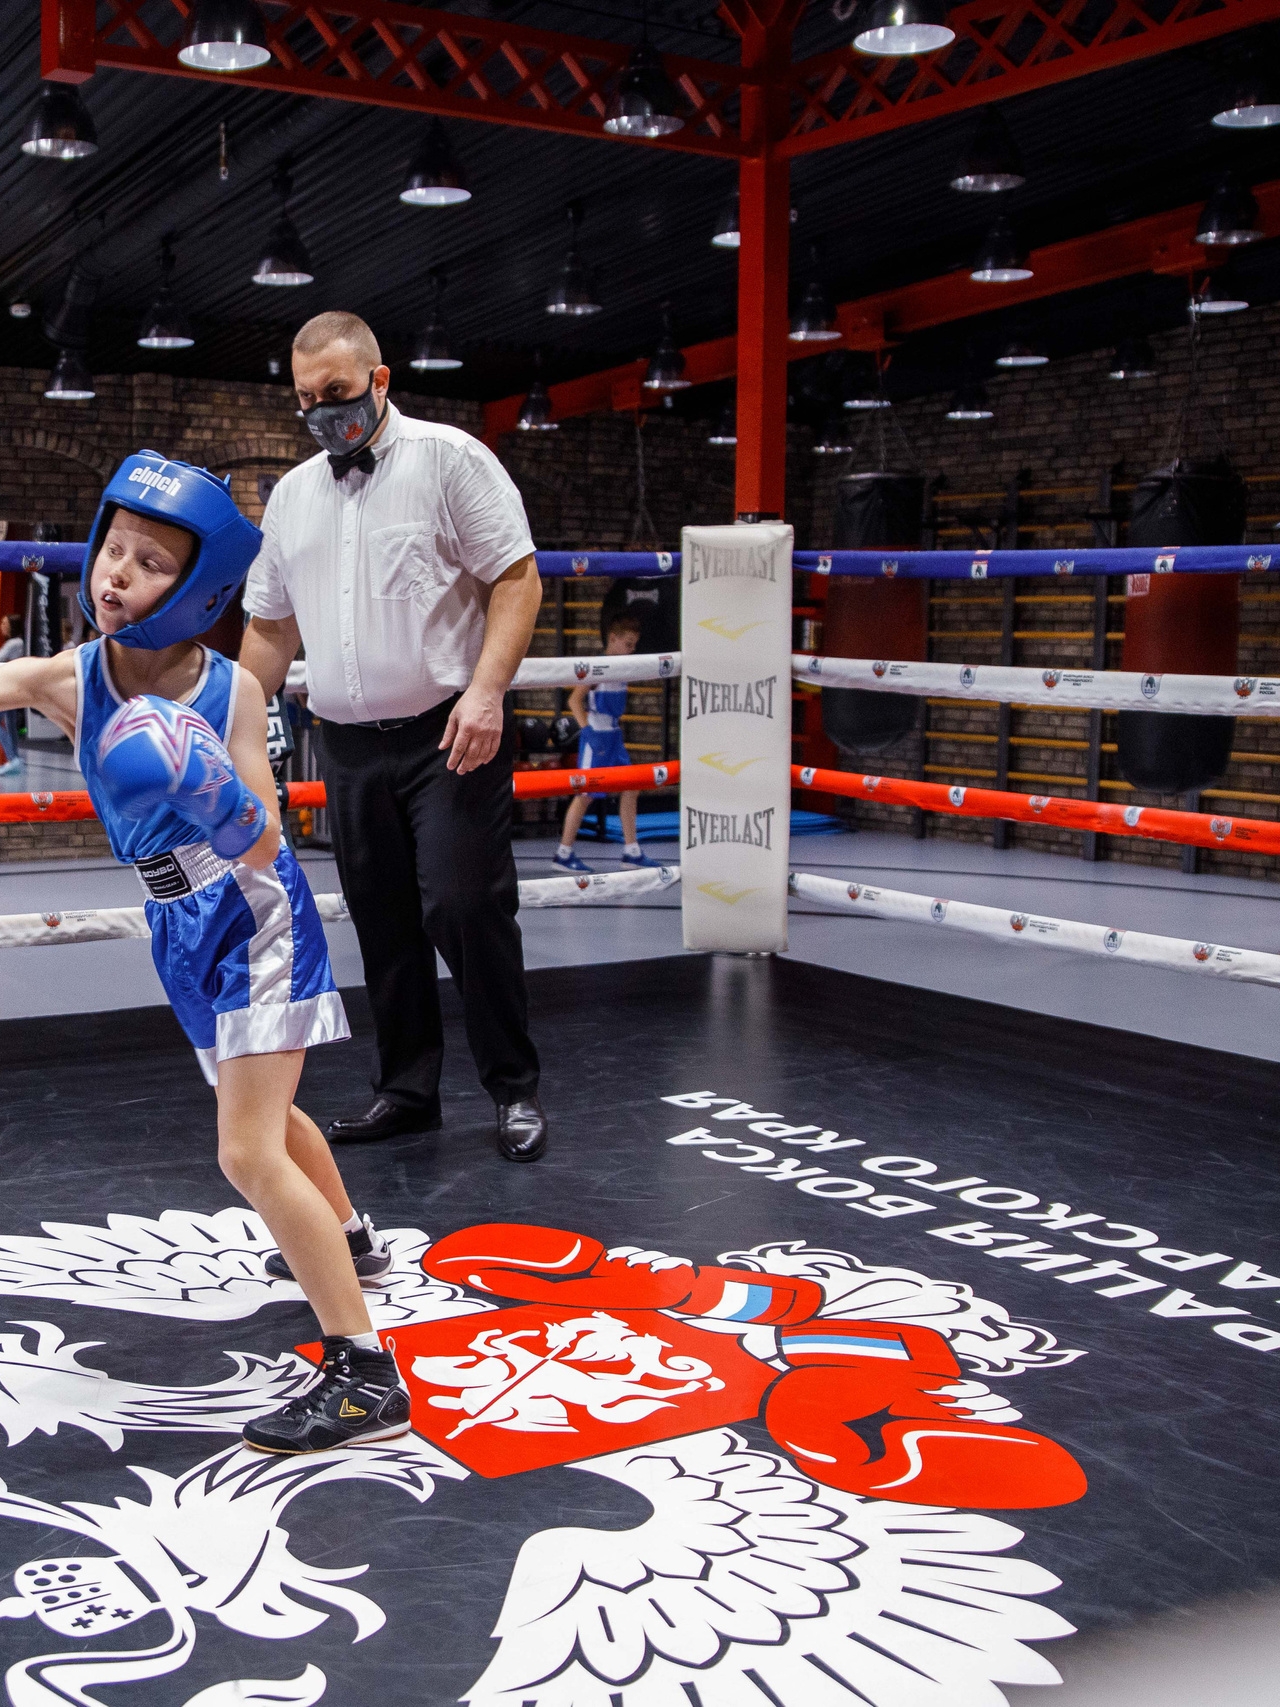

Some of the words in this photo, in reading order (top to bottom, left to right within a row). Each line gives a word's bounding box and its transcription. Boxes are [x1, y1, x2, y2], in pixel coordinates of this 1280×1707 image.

[128, 466, 182, 497] clinch
[688, 541, 785, 584] EVERLAST
[687, 675, 777, 730] EVERLAST
[686, 806, 775, 850] EVERLAST
[660, 1090, 866, 1152] КРАЯ
[666, 1127, 937, 1218] БОКСА
